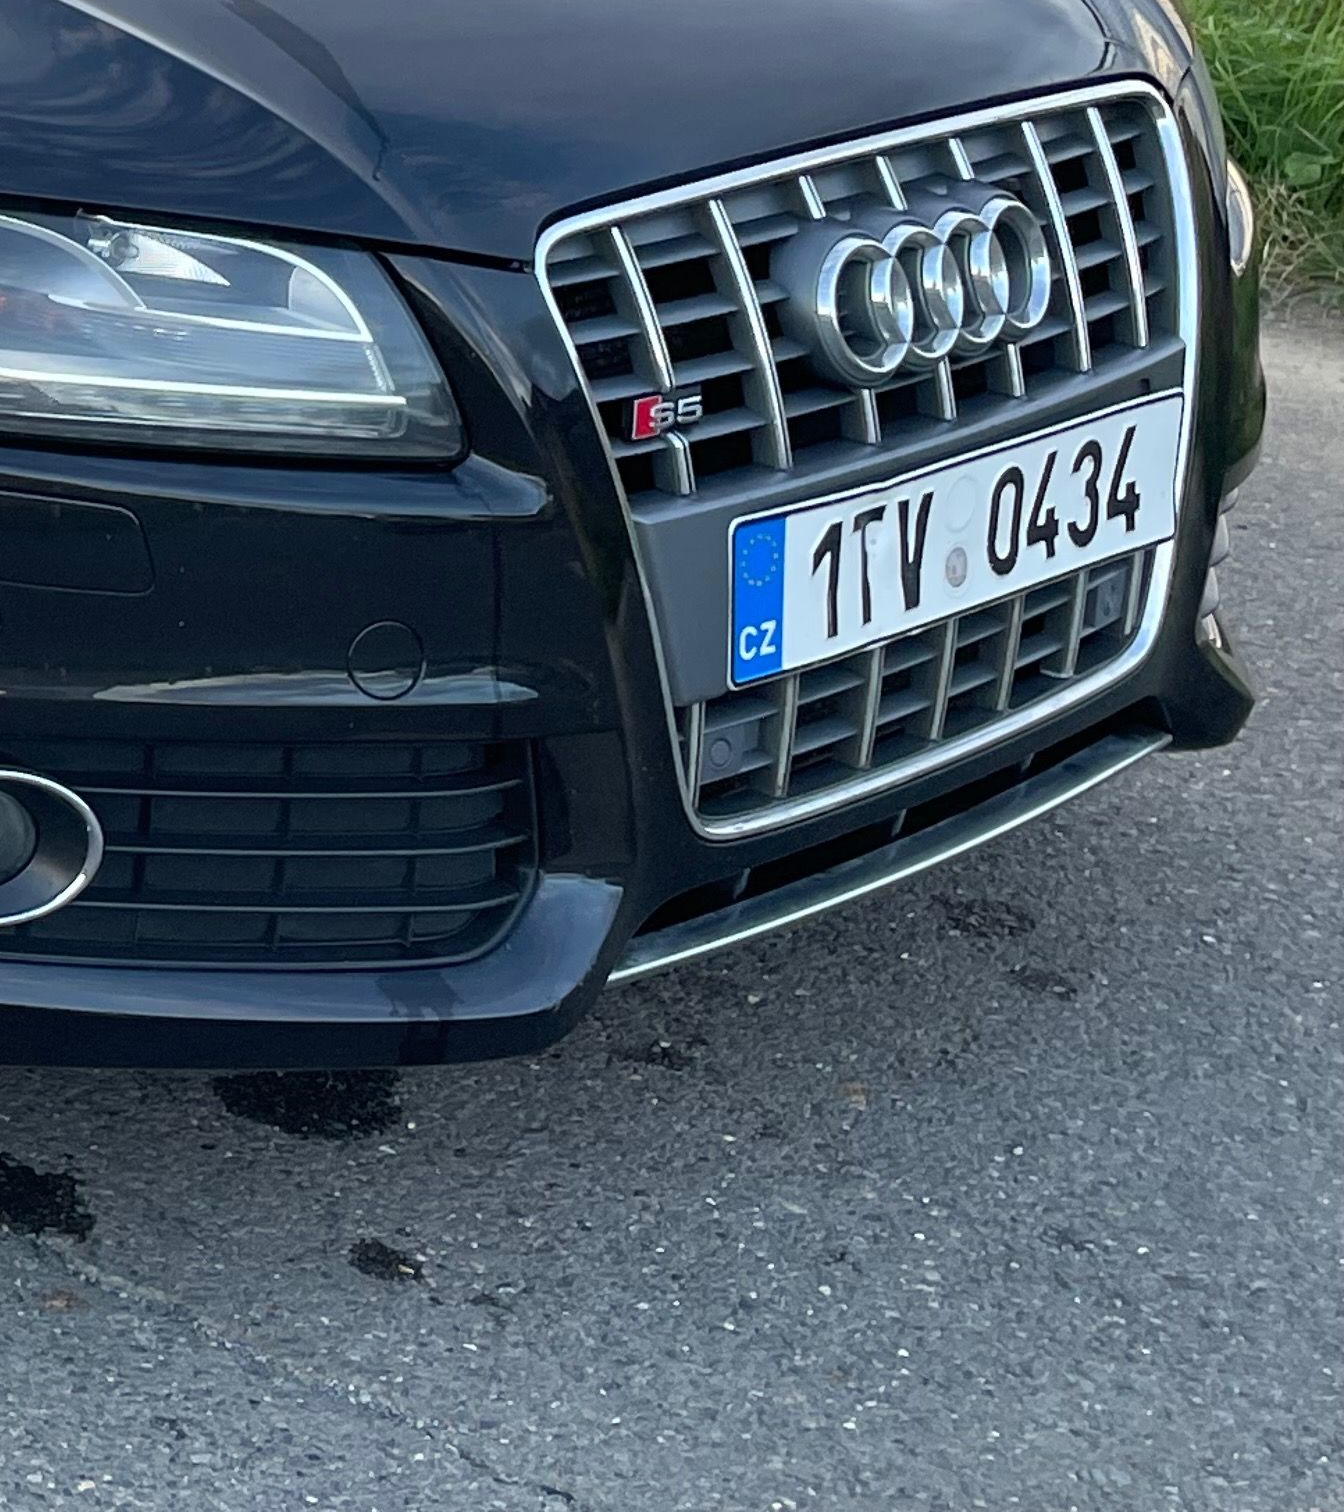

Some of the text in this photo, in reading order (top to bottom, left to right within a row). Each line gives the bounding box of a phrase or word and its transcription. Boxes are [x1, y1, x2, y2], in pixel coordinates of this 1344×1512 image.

[649, 395, 703, 428] S5
[811, 424, 1141, 639] 1TV 0434
[738, 620, 777, 661] CZ
